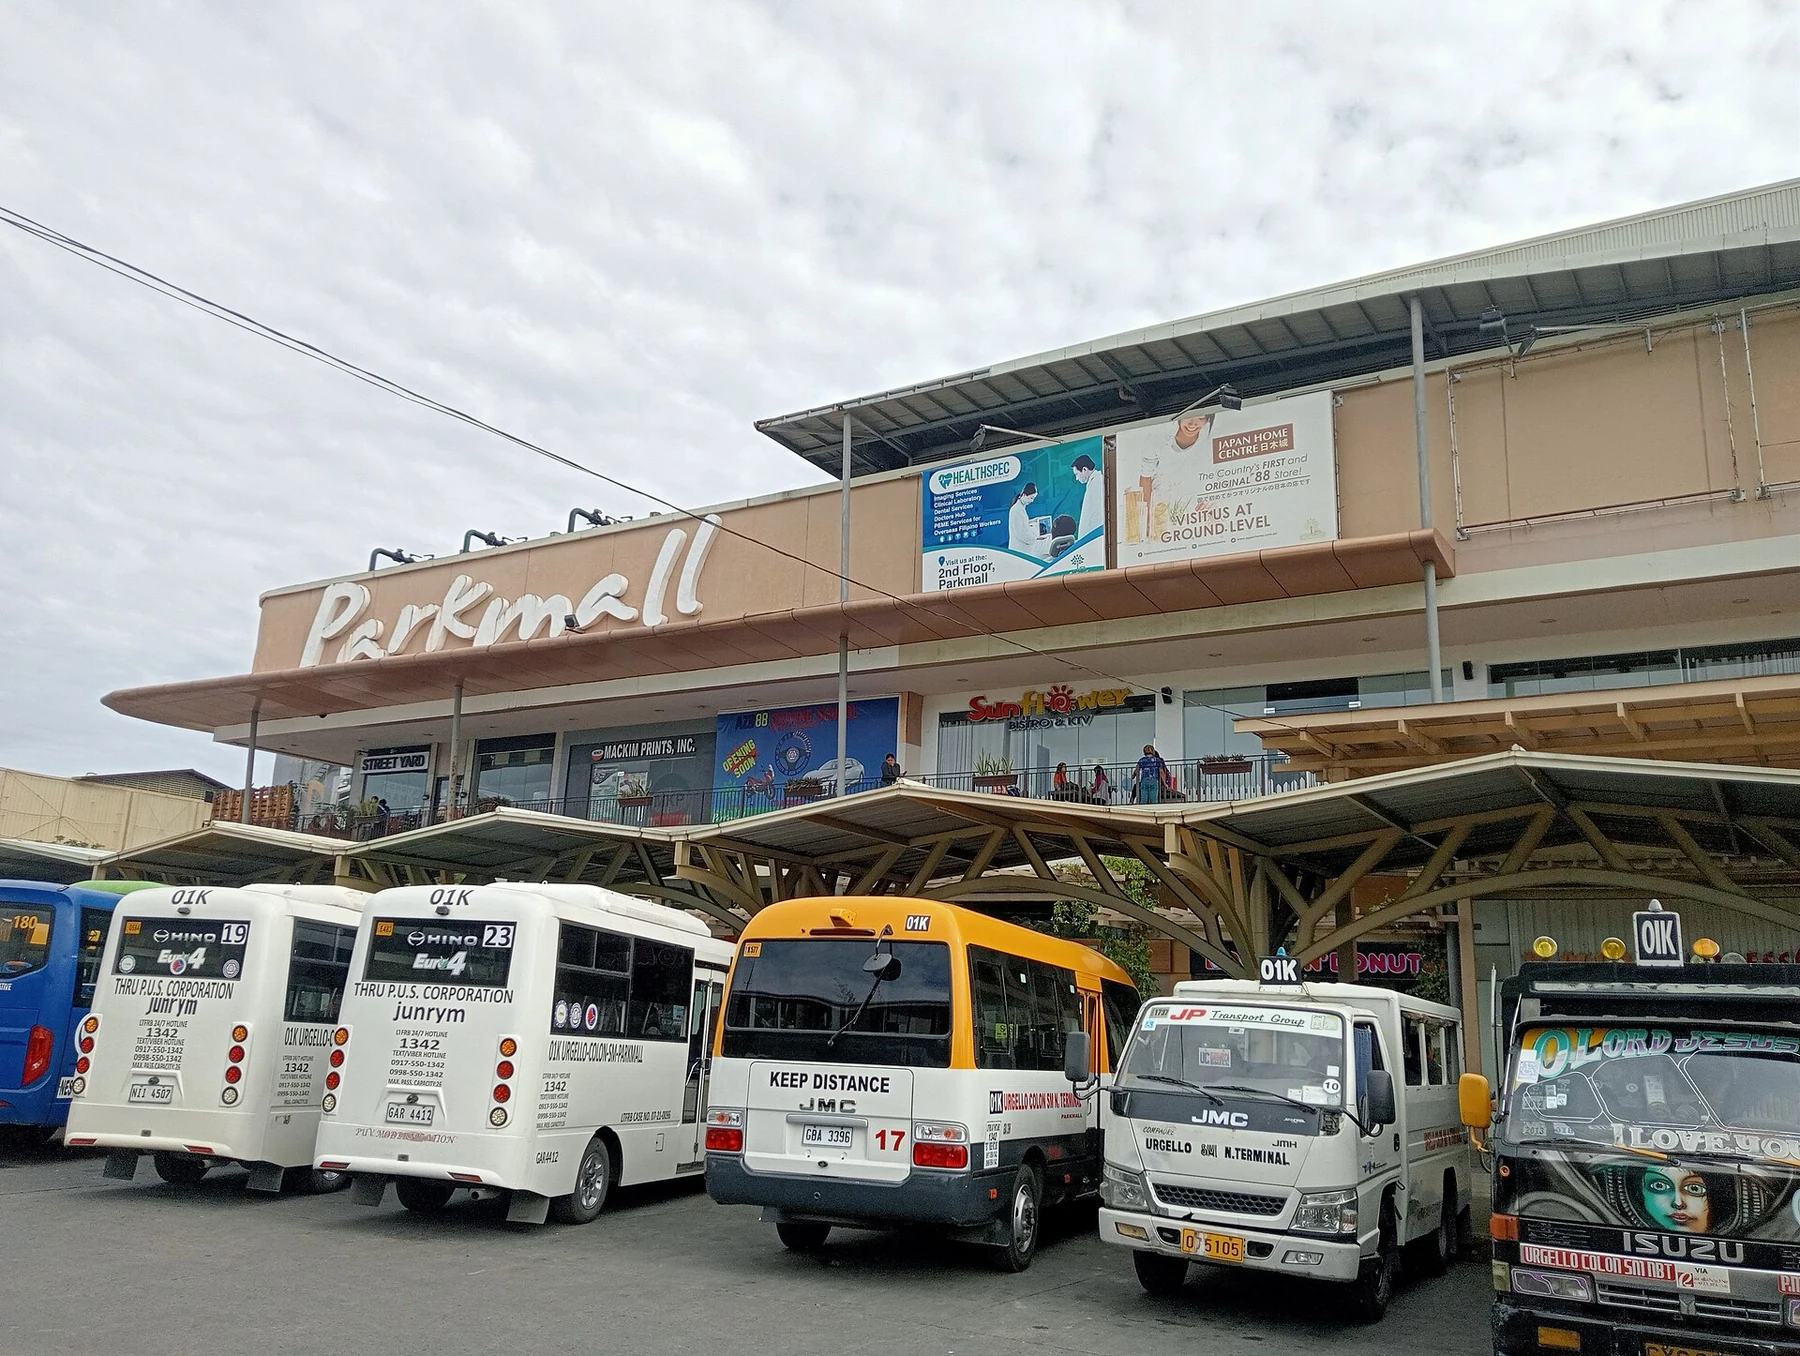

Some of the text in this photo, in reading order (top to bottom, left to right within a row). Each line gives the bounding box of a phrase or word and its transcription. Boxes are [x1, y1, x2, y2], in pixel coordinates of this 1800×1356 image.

[1218, 428, 1288, 451] JAPAN HOME
[1218, 444, 1258, 459] CENTRE
[953, 461, 1010, 485] HEALTHSPEC
[1199, 454, 1308, 480] The Country's FIRST and
[1205, 477, 1250, 491] ORIGINAL
[1275, 467, 1302, 479] Store!
[934, 489, 977, 502] Imaging Services
[934, 495, 982, 509] Clinical Laboratory
[934, 503, 974, 515] Dental Services
[1176, 503, 1253, 526] VISIT US AT
[934, 514, 954, 522] Doctors
[950, 517, 972, 526] Services
[934, 519, 1001, 536] Overseas Filipino Workers
[1161, 523, 1225, 543] GROUND
[1230, 515, 1271, 532] LEVEL
[938, 562, 996, 578] 2nd Floor,
[946, 558, 959, 566] Visit
[939, 572, 988, 590] Parkmall
[300, 513, 723, 668] Parkmall
[1008, 714, 1094, 731] BISTRO & KTV
[603, 738, 695, 759] MACKIM PRINTS, INC.
[722, 739, 756, 772] OPENING
[362, 754, 425, 771] STREET YARD
[733, 756, 756, 778] SOON
[13, 914, 38, 929] 180
[906, 915, 928, 930] 01K
[171, 932, 217, 943] HINO
[224, 924, 247, 943] 19
[427, 934, 478, 947] HINO
[484, 926, 511, 946] 23
[1260, 959, 1298, 982] 01K
[114, 978, 234, 999] THRU P.U.S. CORPORATION
[354, 982, 514, 1004] THRU P.U.S. CORPORATION
[146, 997, 197, 1015] junrym
[393, 1001, 466, 1023] junrym
[154, 1020, 165, 1028] 24/7
[166, 1020, 188, 1028] HOTLINE
[1170, 1009, 1207, 1020] JP
[1211, 1010, 1264, 1023] Transport
[1271, 1014, 1305, 1027] Group
[146, 1027, 178, 1038] 1342
[285, 1027, 297, 1046] 01K
[134, 1045, 183, 1054] 0917-550-1342
[164, 1038, 185, 1046] HOTLINE
[399, 1038, 440, 1050] 1342
[548, 1040, 561, 1061] 01K
[1571, 1028, 1673, 1069] LORD
[1675, 1030, 1800, 1054] JESUS
[133, 1054, 182, 1062] 0998-550-1342
[393, 1049, 446, 1059] TEXT/VIBER HOTLINE
[285, 1062, 309, 1073] 1342
[390, 1059, 445, 1068] 0917-550-1342
[389, 1068, 444, 1078] 0998-550-1342
[544, 1081, 566, 1092] 1342
[770, 1071, 890, 1093] KEEP DISTANCE
[1325, 1081, 1339, 1091] 10
[151, 1089, 171, 1099] 4507
[1003, 1093, 1028, 1110] URGELLO
[1029, 1092, 1046, 1110] COLON
[1046, 1092, 1054, 1109] SM
[799, 1097, 857, 1113] JMC
[388, 1109, 432, 1121] GAR 4412
[1191, 1109, 1249, 1127] JMC
[805, 1128, 850, 1144] GBA 3396
[875, 1129, 905, 1151] 17
[1629, 1126, 1735, 1151] LOVE
[1146, 1137, 1192, 1153] URGELLO
[1225, 1146, 1290, 1166] N.TERMINAL
[1623, 1231, 1745, 1264] ISUZU
[1524, 1246, 1579, 1268] URGELLO
[1581, 1254, 1623, 1273] COLON
[1695, 1267, 1708, 1275] VIA
